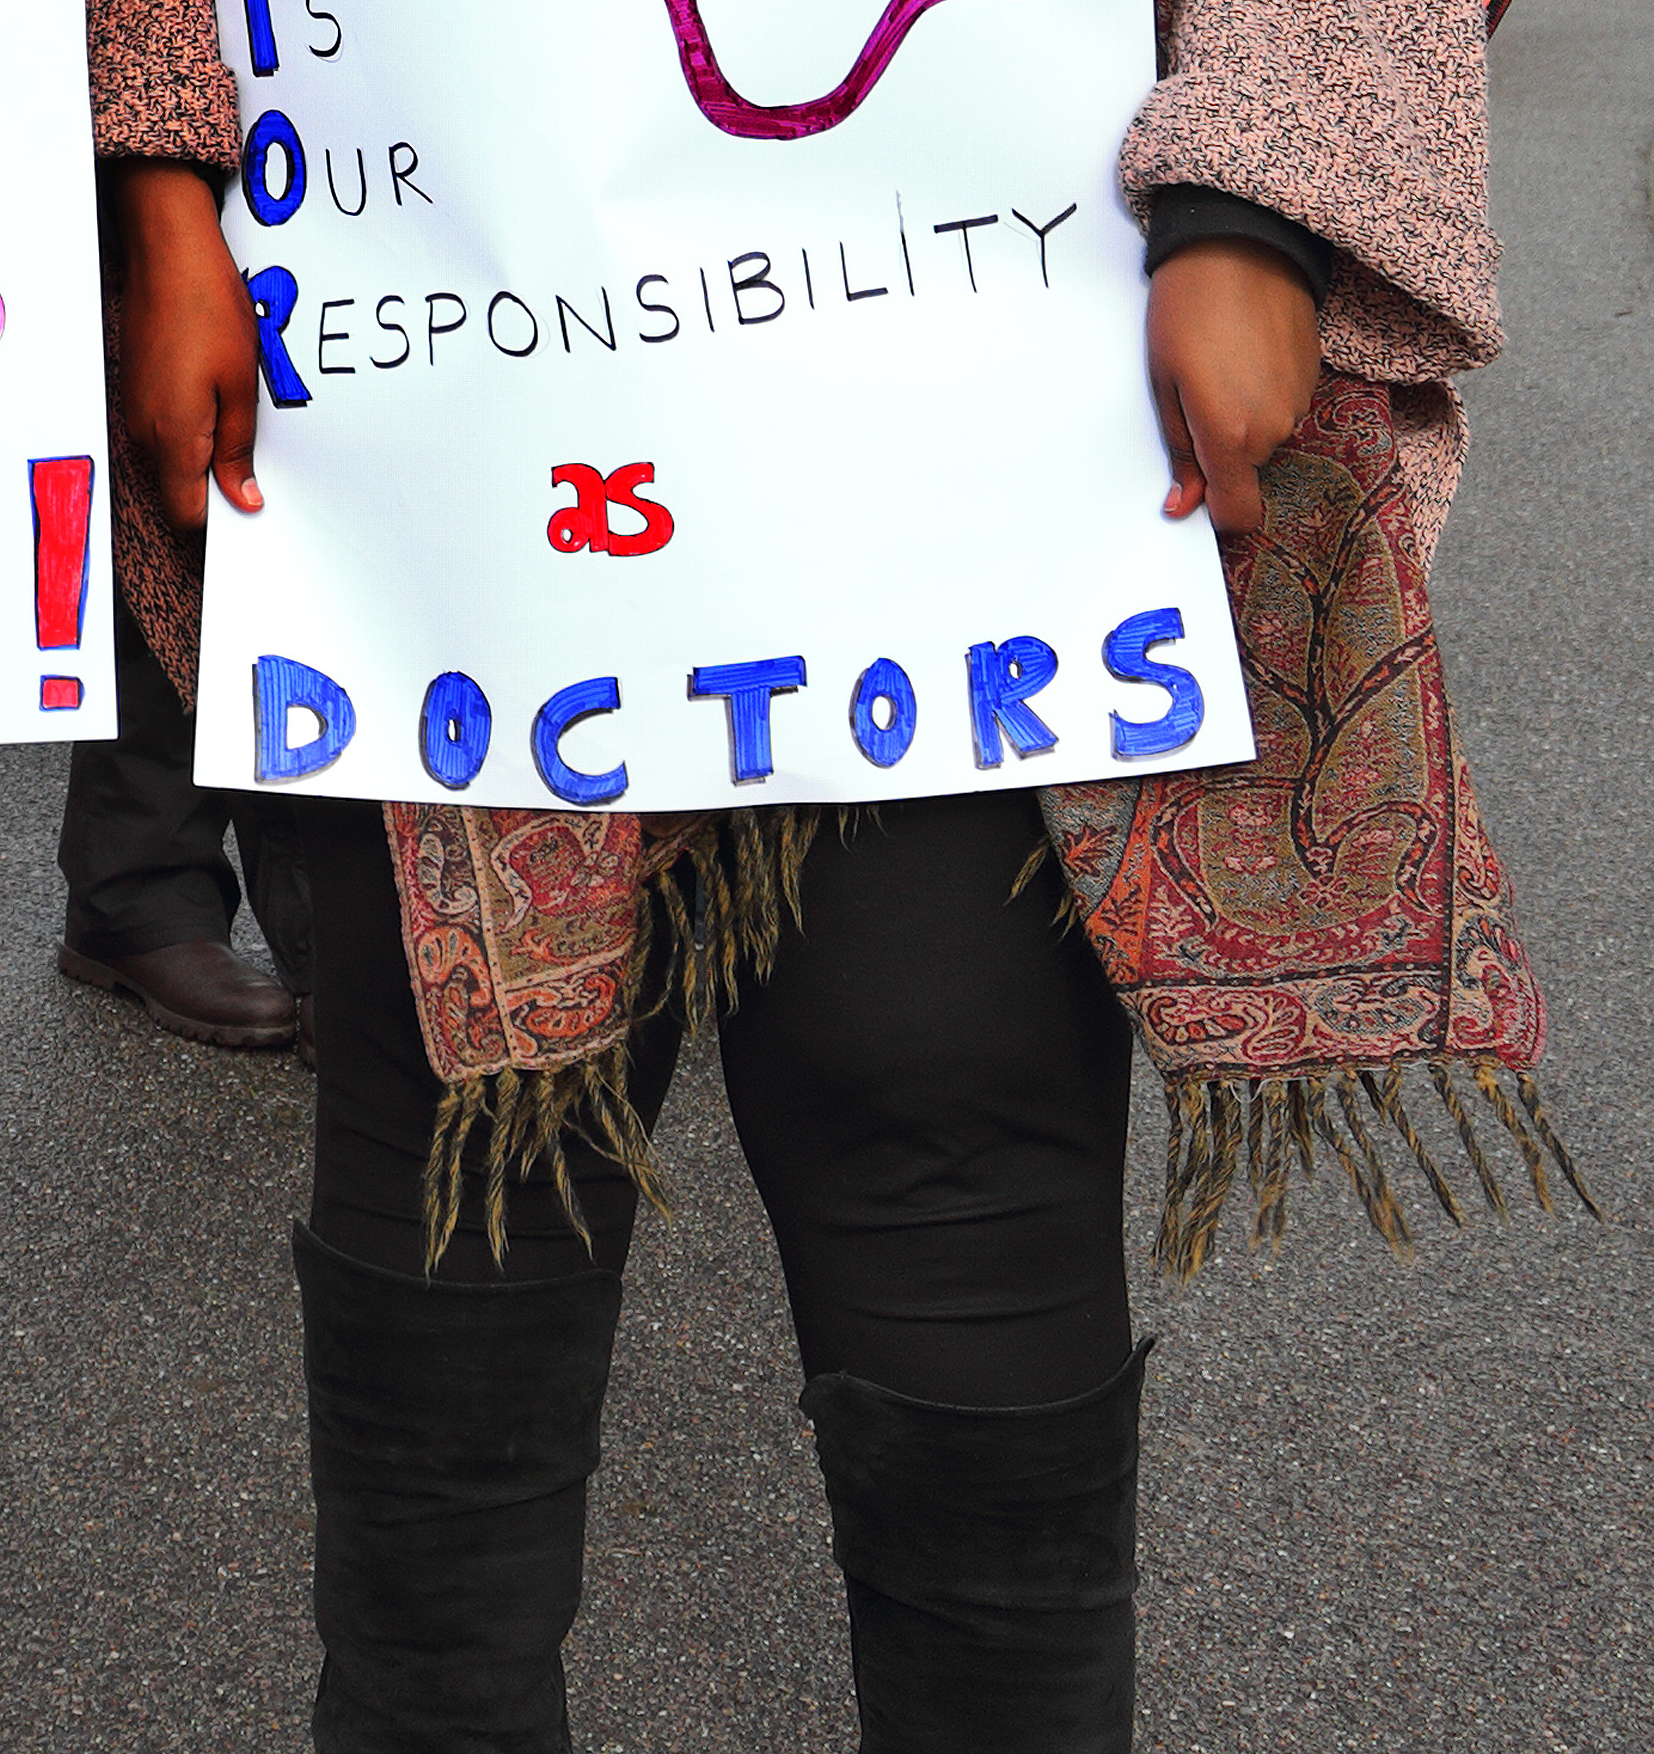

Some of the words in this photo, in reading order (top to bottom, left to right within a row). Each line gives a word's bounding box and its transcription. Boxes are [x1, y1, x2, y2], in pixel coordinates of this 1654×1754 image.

[242, 109, 434, 227] OUR
[243, 191, 1078, 409] RESPONSIBILITY
[253, 608, 1205, 806] DOCTORS
